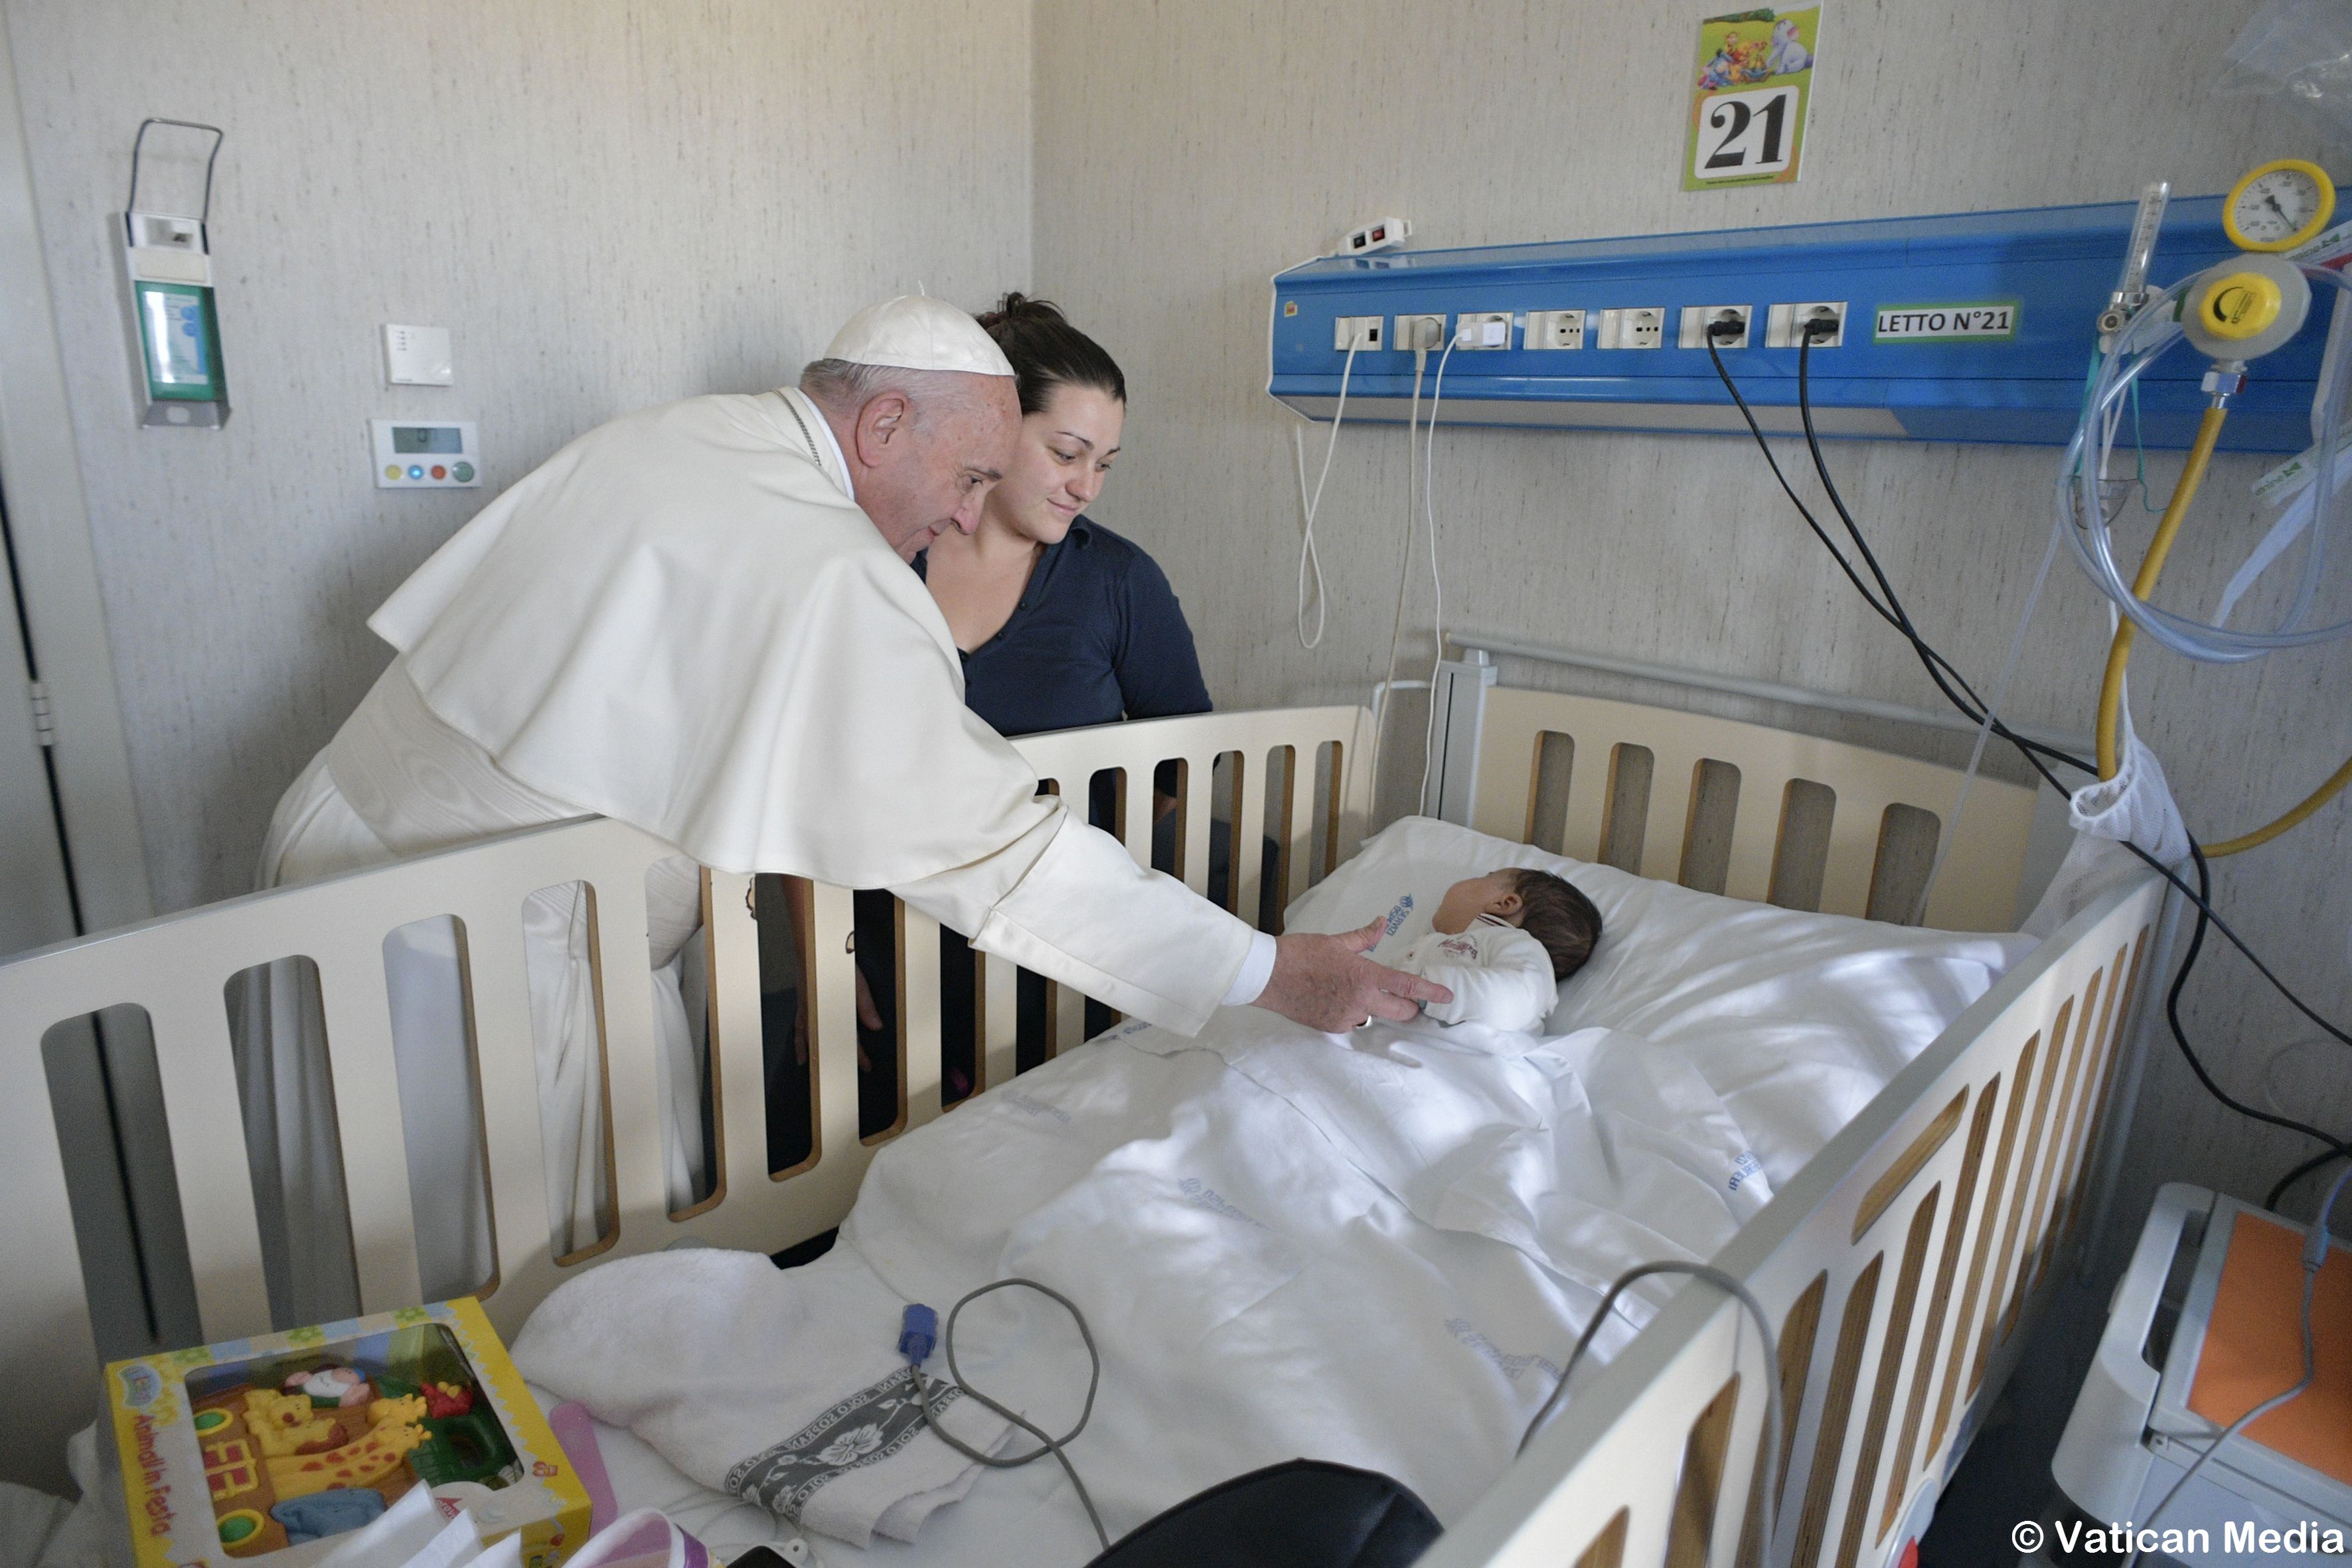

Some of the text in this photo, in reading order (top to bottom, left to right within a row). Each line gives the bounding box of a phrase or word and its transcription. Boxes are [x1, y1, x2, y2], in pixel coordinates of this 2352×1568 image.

[1705, 94, 1787, 169] 21
[1878, 311, 2009, 333] LETTO N°21
[145, 1484, 177, 1537] Festa
